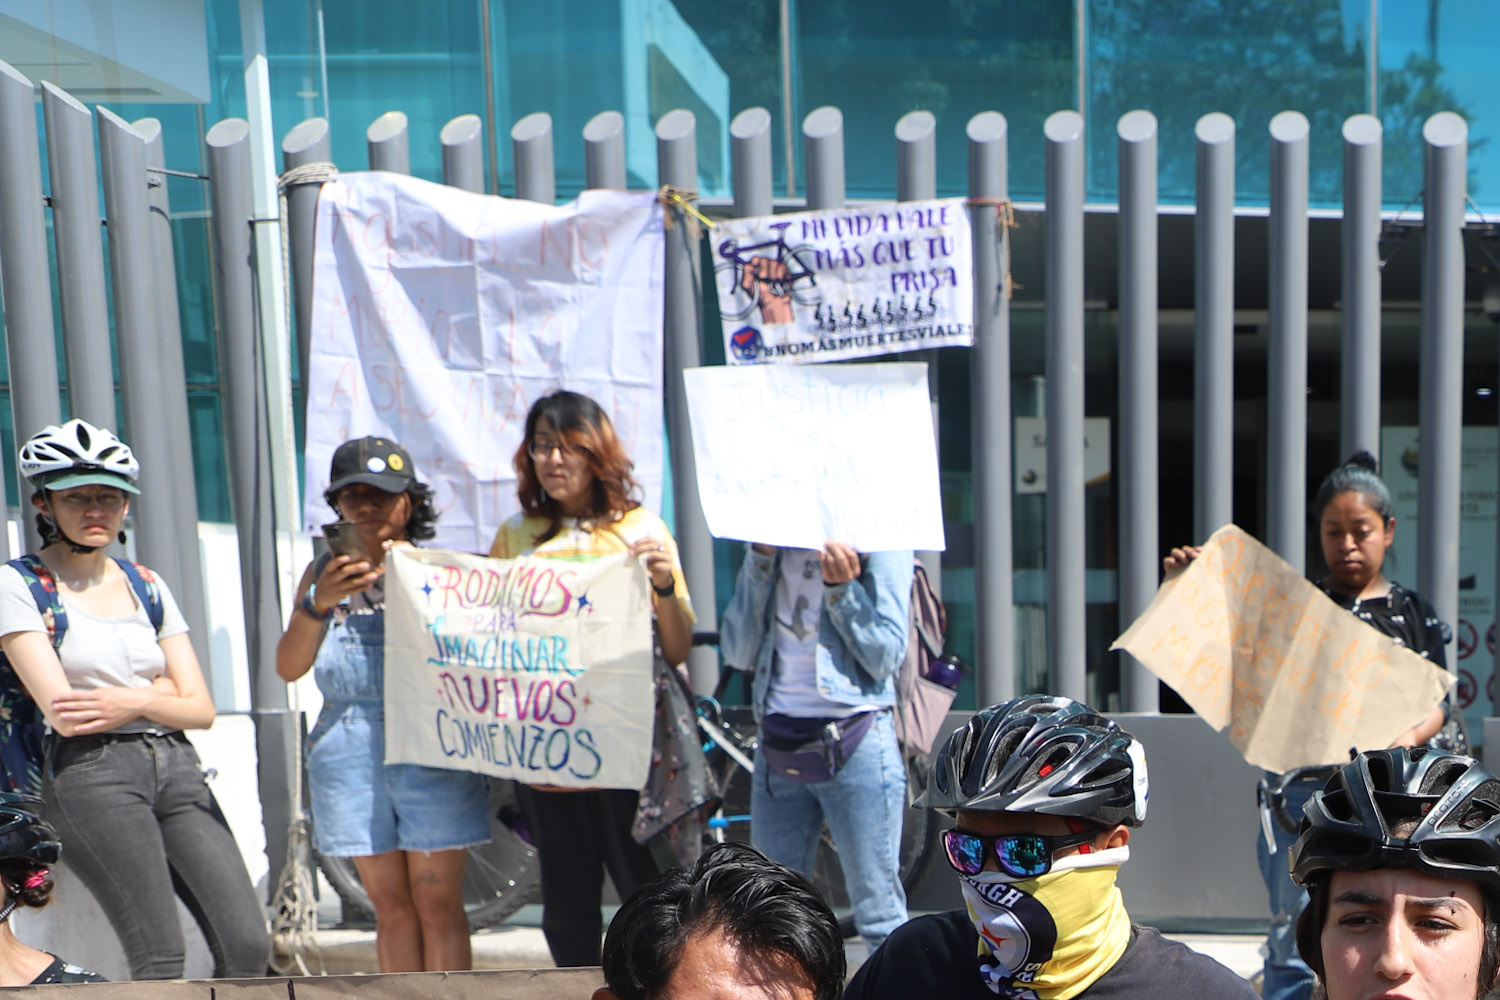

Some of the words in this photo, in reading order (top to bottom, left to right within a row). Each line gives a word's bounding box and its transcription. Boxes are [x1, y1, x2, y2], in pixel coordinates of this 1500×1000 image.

[801, 219, 826, 241] MI
[834, 213, 889, 238] VIDA
[873, 240, 918, 267] QUE
[926, 235, 954, 260] TU
[891, 266, 958, 293] PRISA
[472, 612, 518, 634] PARA
[1332, 639, 1390, 690] NO
[435, 708, 602, 780] COMIENZOS
